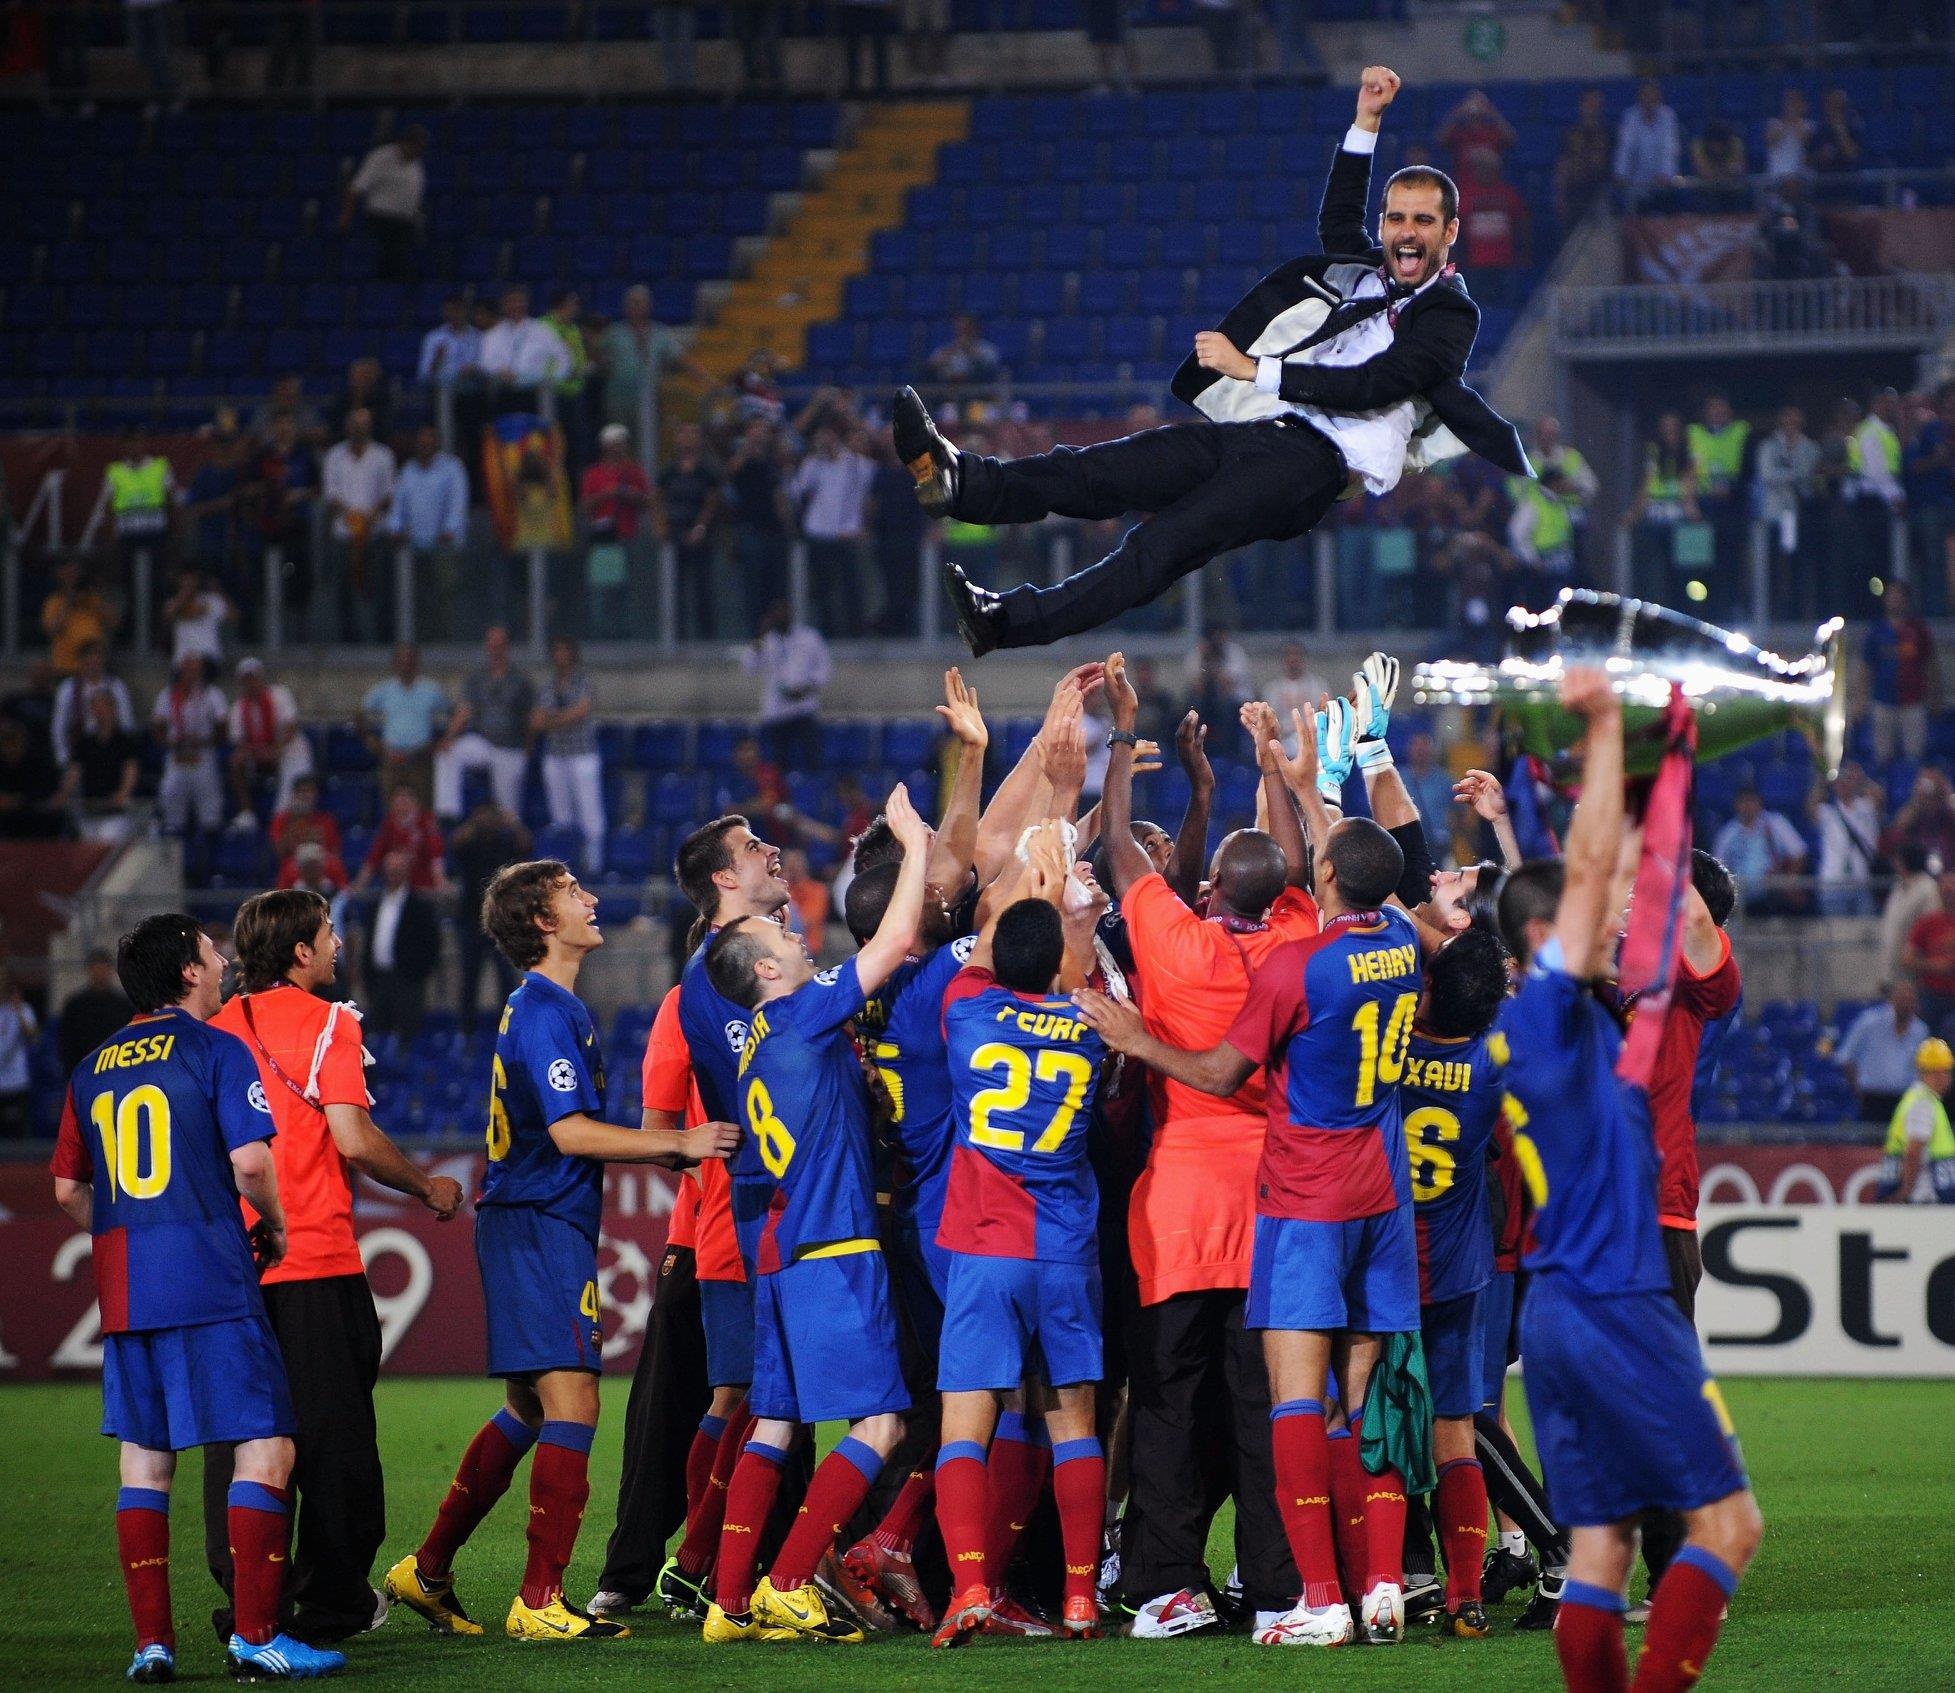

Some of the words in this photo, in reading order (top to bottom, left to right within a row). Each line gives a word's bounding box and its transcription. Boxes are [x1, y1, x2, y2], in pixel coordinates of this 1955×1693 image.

[1348, 944, 1416, 983] HENRY
[94, 1035, 175, 1075] MESSI
[1403, 1058, 1472, 1092] XAVI
[747, 1077, 797, 1179] 8
[969, 1042, 1093, 1153] 27
[91, 1084, 171, 1204] 10
[1404, 1106, 1461, 1203] 6
[1366, 1491, 1406, 1503] BARÇA
